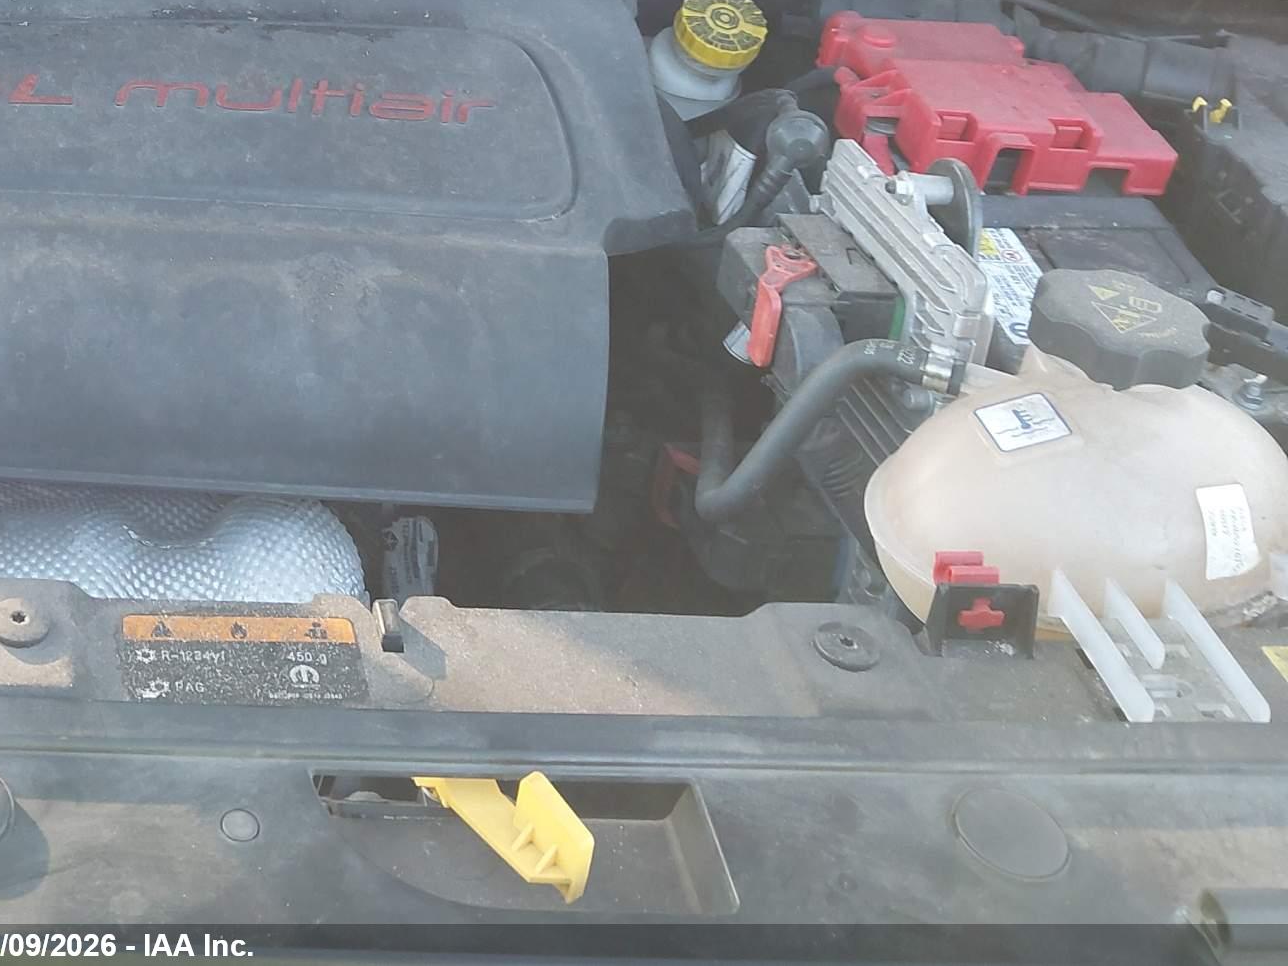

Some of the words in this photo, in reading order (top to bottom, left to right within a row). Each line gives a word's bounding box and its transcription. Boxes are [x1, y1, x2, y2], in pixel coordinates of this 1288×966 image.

[114, 77, 498, 125] multiair
[286, 651, 313, 663] 450
[174, 680, 205, 693] PAG
